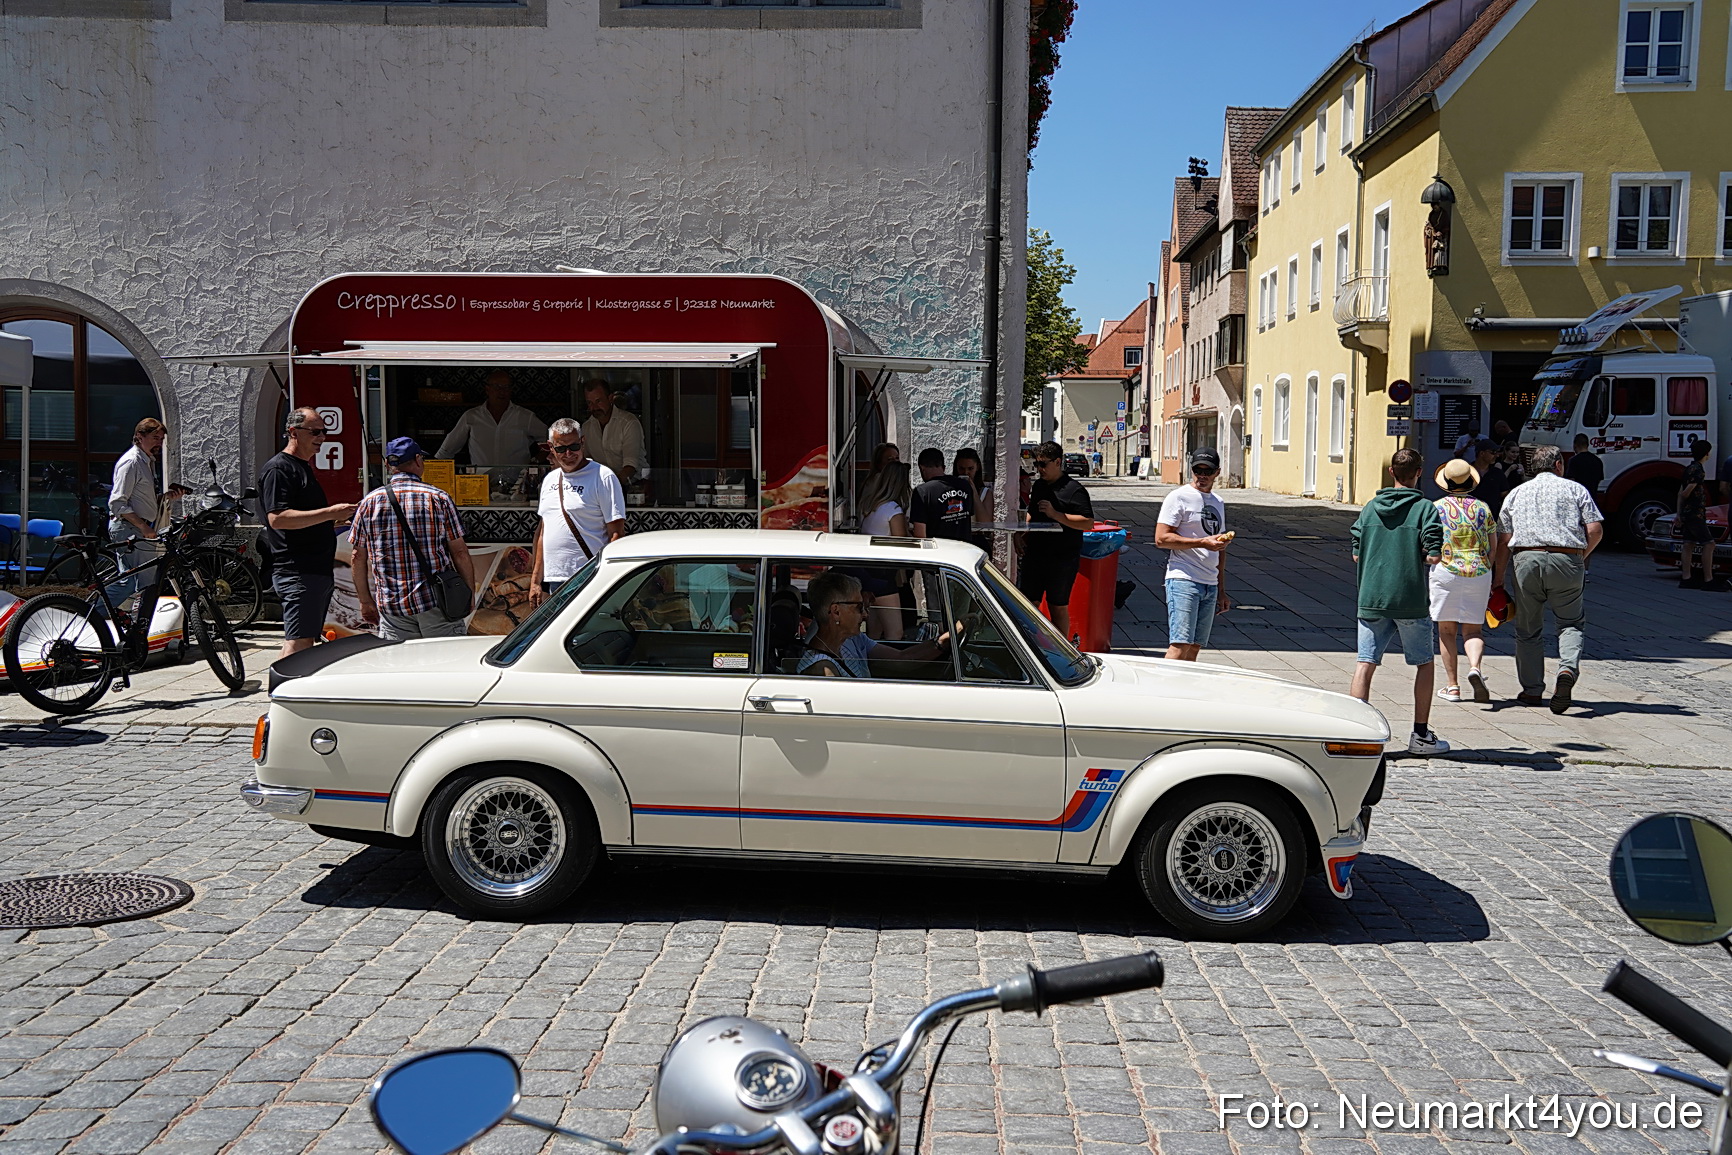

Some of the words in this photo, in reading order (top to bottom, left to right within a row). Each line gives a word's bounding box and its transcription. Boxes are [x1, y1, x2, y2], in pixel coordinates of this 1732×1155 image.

[337, 291, 457, 318] Creppresso
[469, 298, 530, 312] Espressobar
[532, 299, 541, 311] &
[543, 298, 584, 312] Creperie
[595, 298, 661, 311] Klostergasse
[663, 299, 672, 308] 5
[680, 299, 717, 312] 92318
[720, 298, 775, 309] Neumarkt
[938, 490, 968, 503] LONDON
[1079, 779, 1117, 791] turbo
[1220, 851, 1228, 868] BBS
